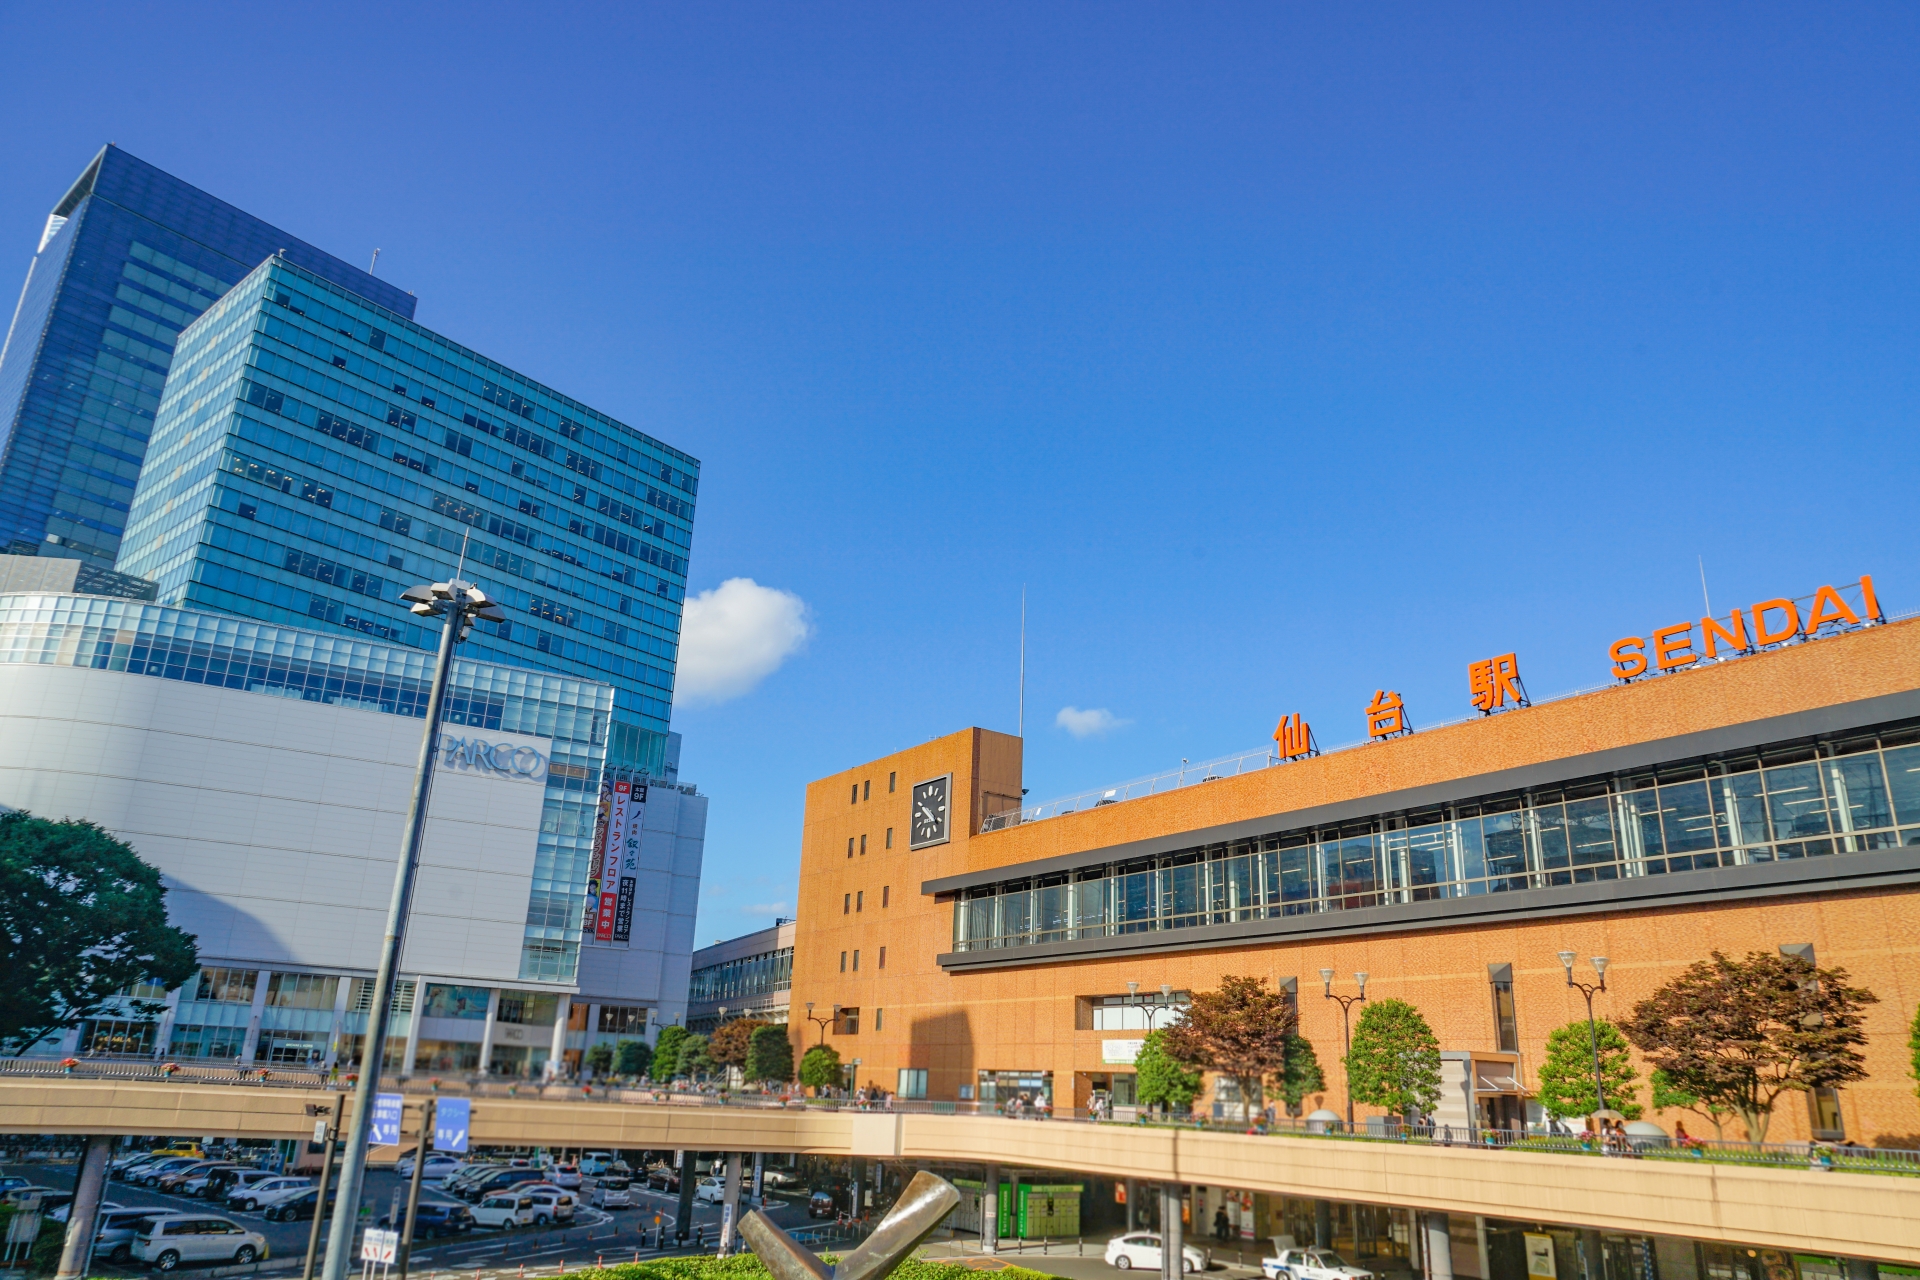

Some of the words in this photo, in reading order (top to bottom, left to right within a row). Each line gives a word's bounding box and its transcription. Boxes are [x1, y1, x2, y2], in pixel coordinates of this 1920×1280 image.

[1608, 574, 1882, 680] SENDAI
[1272, 652, 1522, 760] 仙台駅
[438, 733, 541, 775] PARCO
[618, 784, 628, 792] 9F
[633, 792, 644, 801] 9F
[606, 795, 626, 889] レストランフロア
[601, 897, 613, 929] 営業中
[440, 1107, 466, 1117] タクシー
